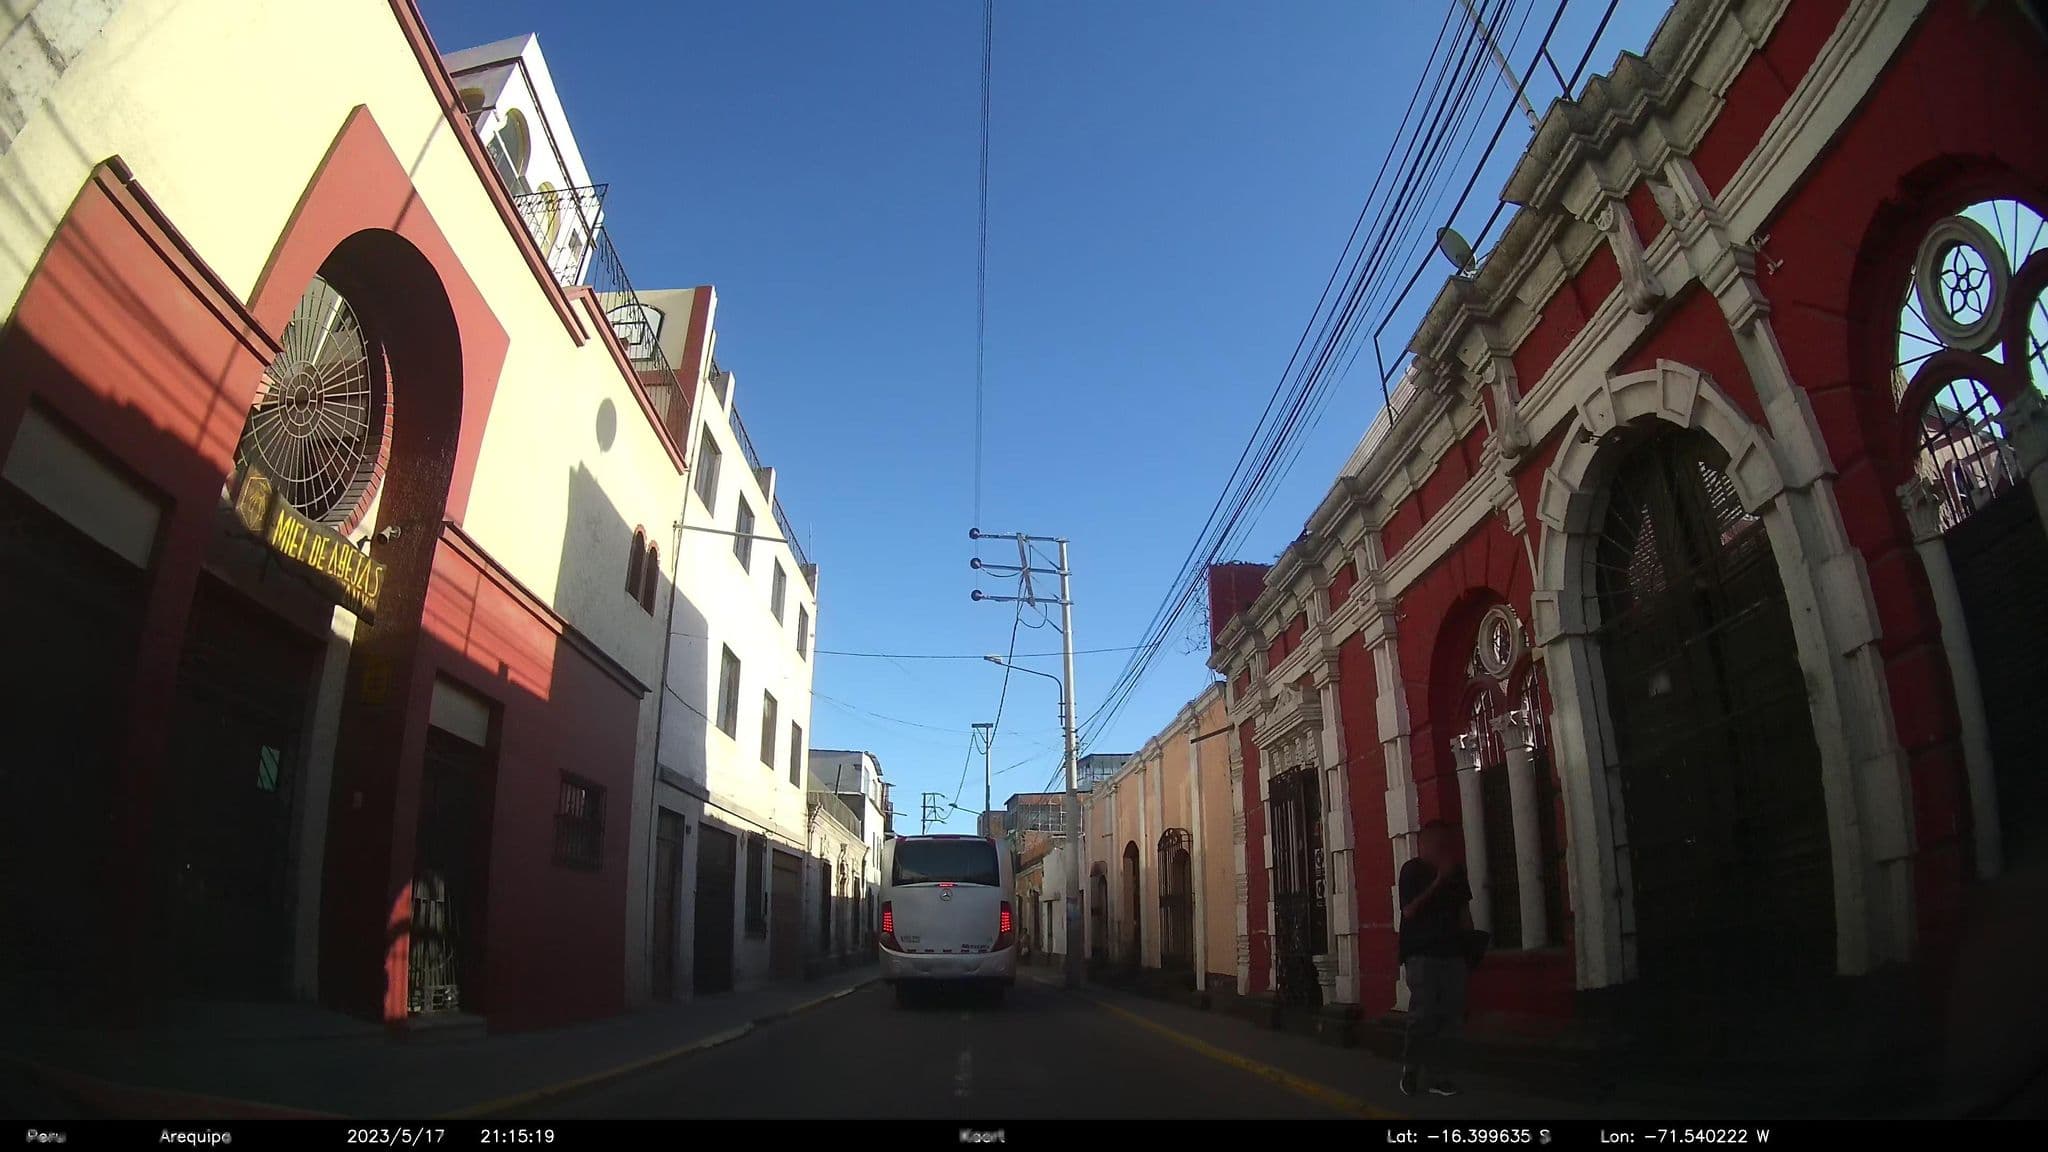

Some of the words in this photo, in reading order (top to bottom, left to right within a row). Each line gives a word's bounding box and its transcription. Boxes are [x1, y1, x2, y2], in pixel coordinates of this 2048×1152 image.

[272, 510, 308, 562] MIEL
[308, 534, 330, 570] DE
[329, 542, 383, 598] ABEJAS
